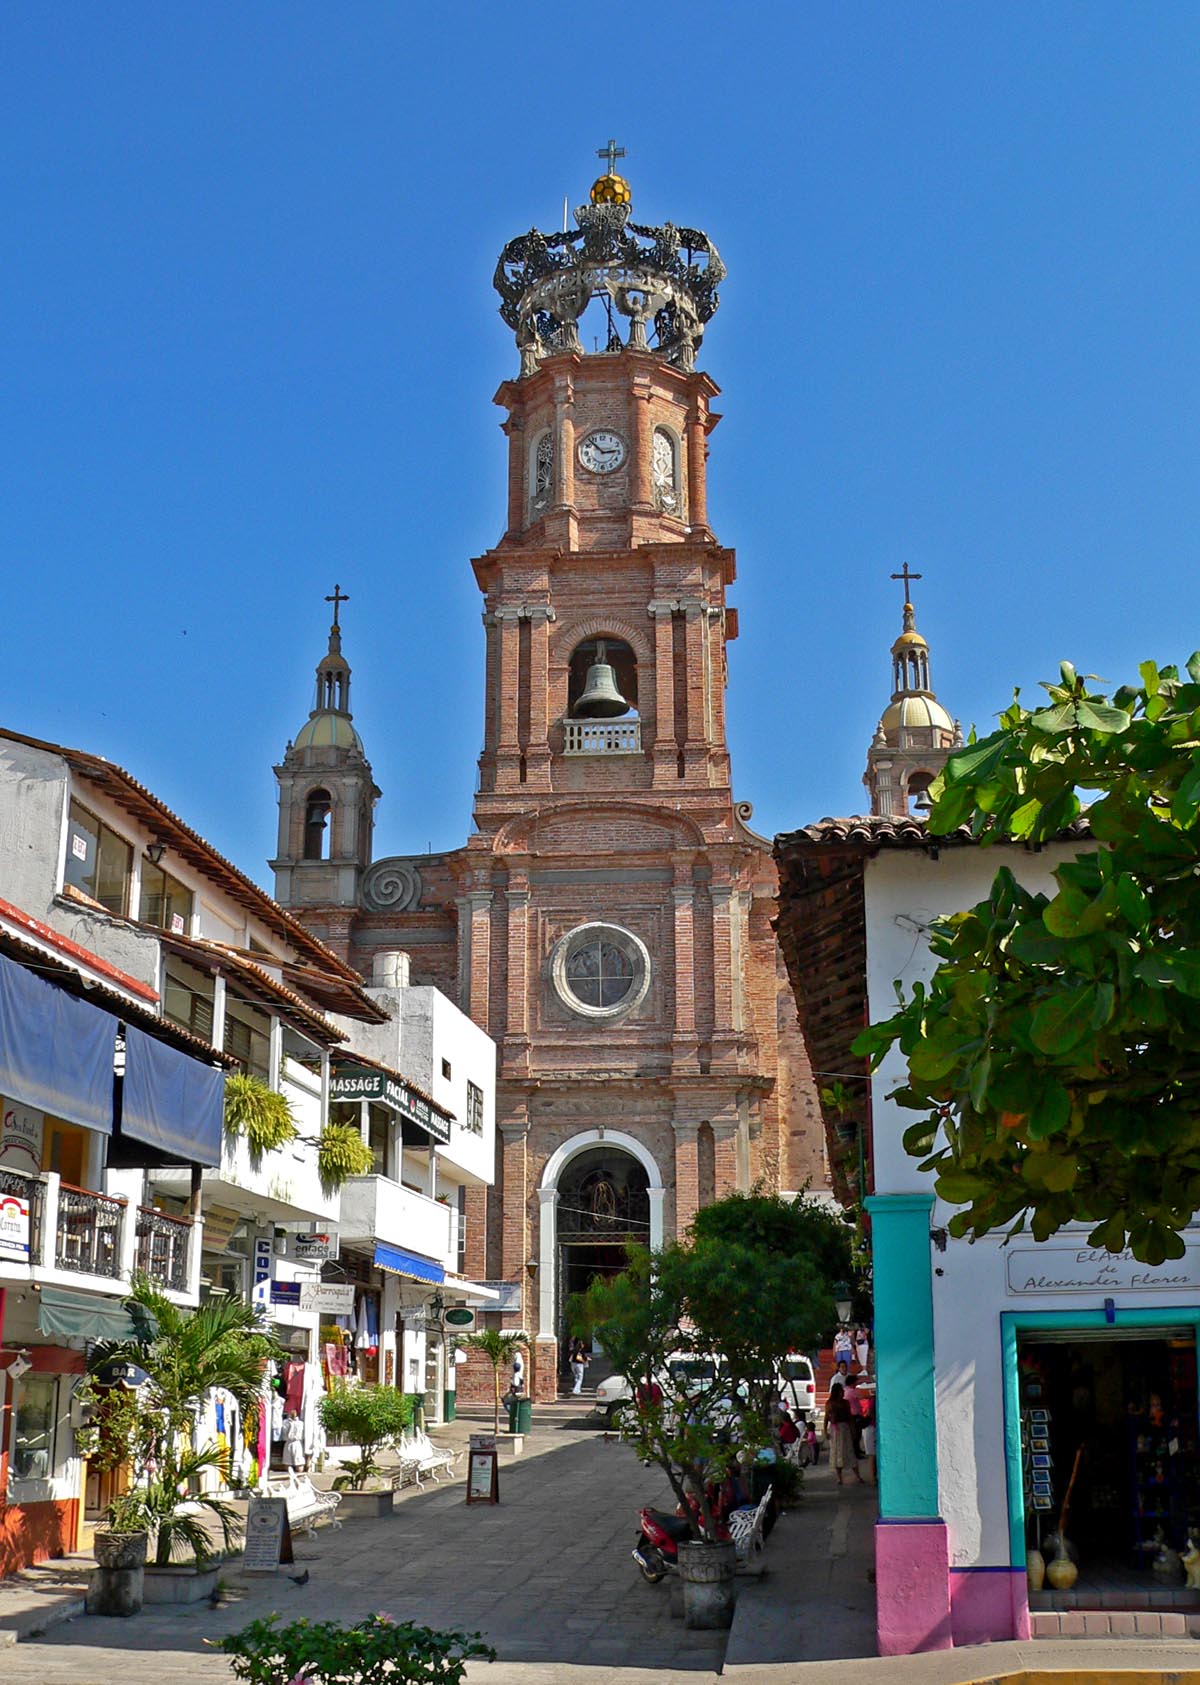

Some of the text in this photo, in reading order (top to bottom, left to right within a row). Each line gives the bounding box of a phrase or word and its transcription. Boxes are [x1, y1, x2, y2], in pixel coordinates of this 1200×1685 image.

[329, 1077, 380, 1092] MASSAGE
[386, 1080, 408, 1106] FACIAL
[1076, 1250, 1098, 1263] El
[1099, 1265, 1118, 1273] de
[1023, 1274, 1122, 1290] Alexander
[1130, 1273, 1191, 1287] Flores
[111, 1367, 136, 1377] BAR
